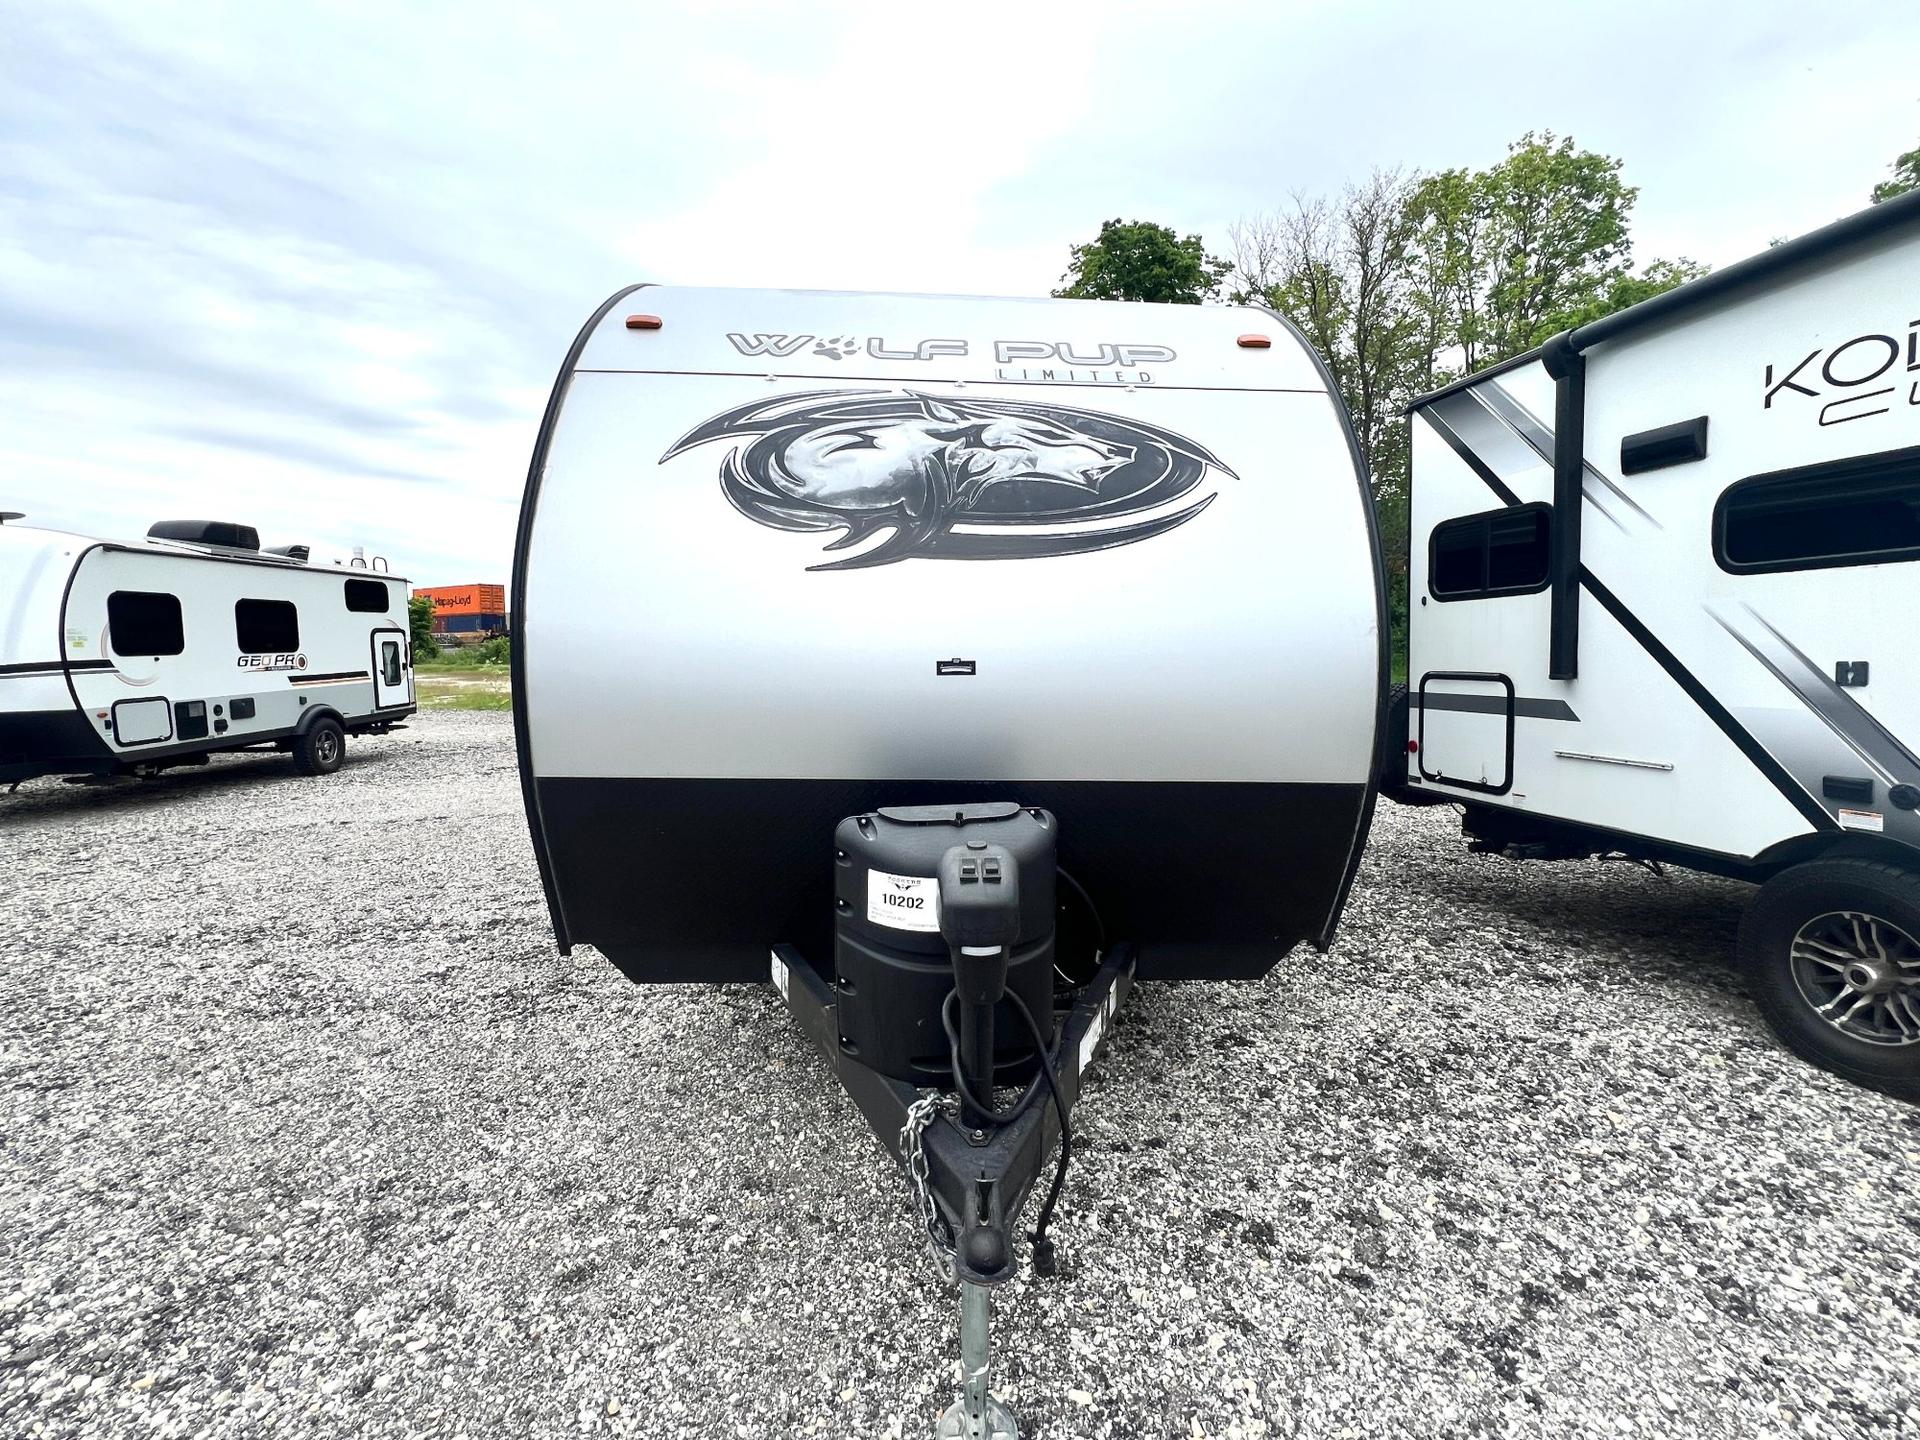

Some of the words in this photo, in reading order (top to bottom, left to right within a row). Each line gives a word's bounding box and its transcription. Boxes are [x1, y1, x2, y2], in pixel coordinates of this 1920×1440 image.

[994, 340, 1177, 367] PUP
[998, 368, 1152, 383] LIMITED
[434, 595, 471, 608] Hapag-Lloyd
[237, 655, 272, 667] GEO
[274, 653, 308, 671] PRO
[882, 893, 924, 909] 10202
